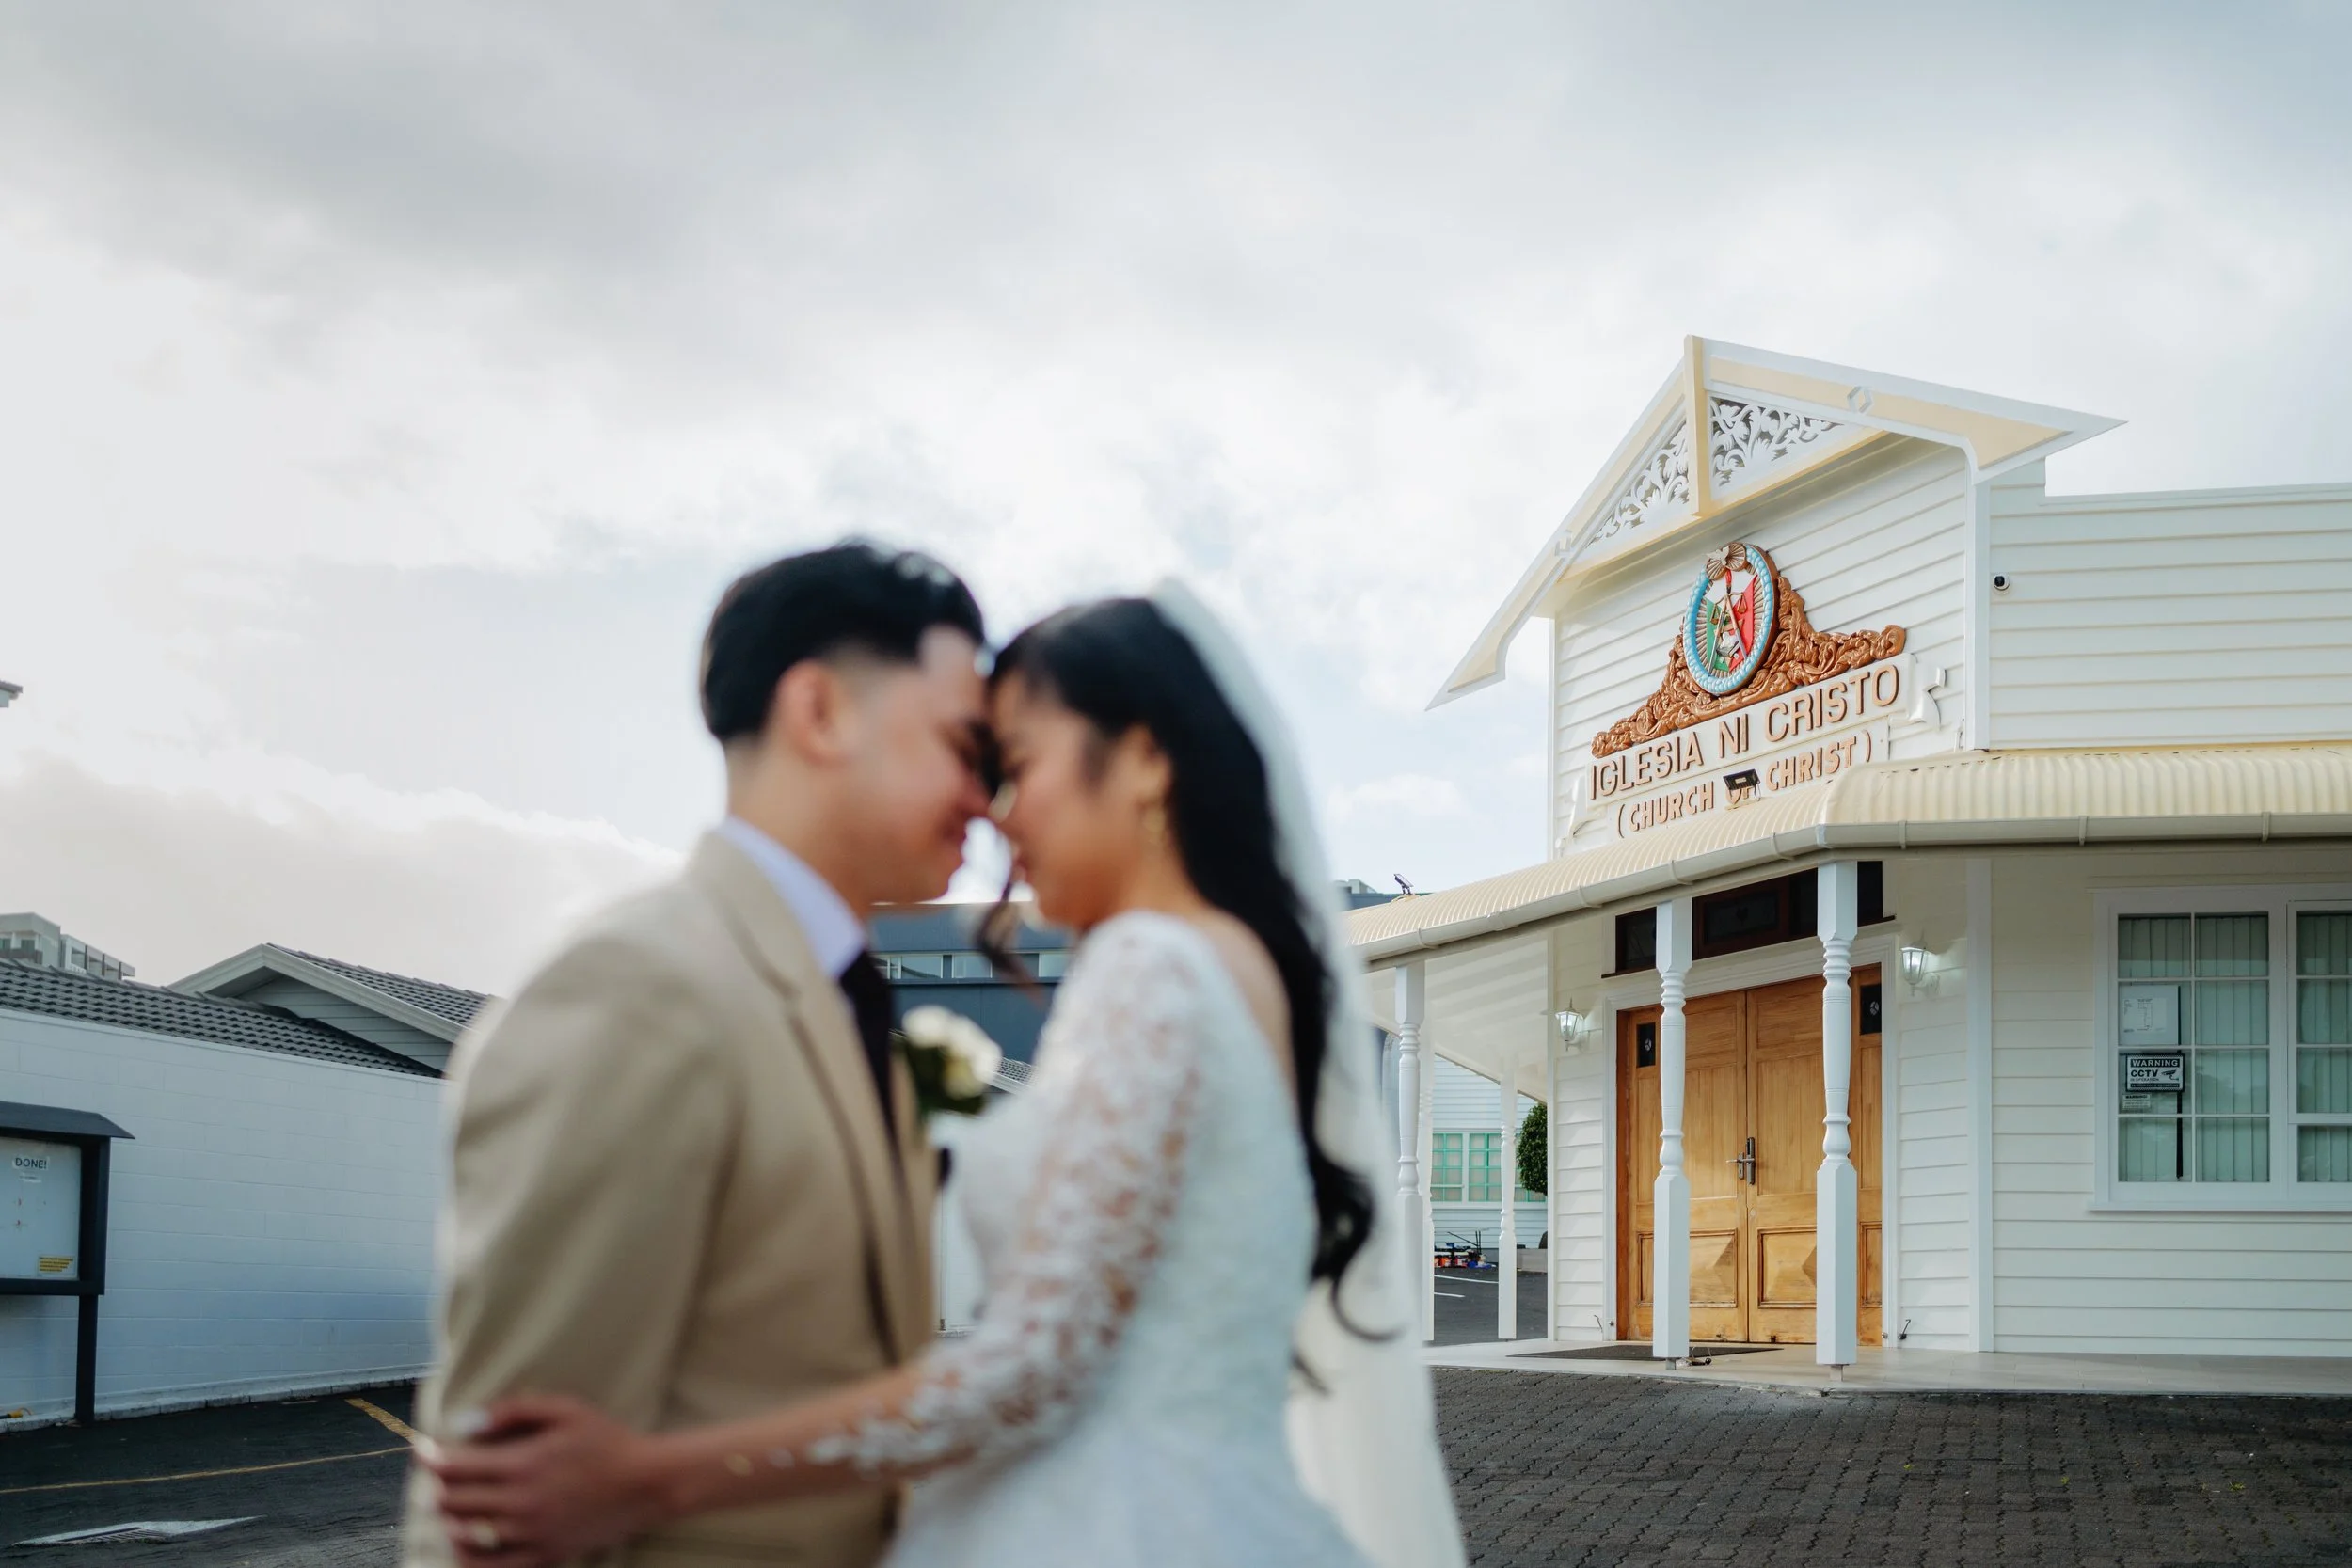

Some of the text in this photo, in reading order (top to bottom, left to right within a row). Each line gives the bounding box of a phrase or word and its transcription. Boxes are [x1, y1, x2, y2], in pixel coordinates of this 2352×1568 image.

[1590, 664, 1899, 800] IGLESIA NI CRISTO
[2130, 1069, 2159, 1078] CCTV
[15, 1157, 47, 1169] DONE!
